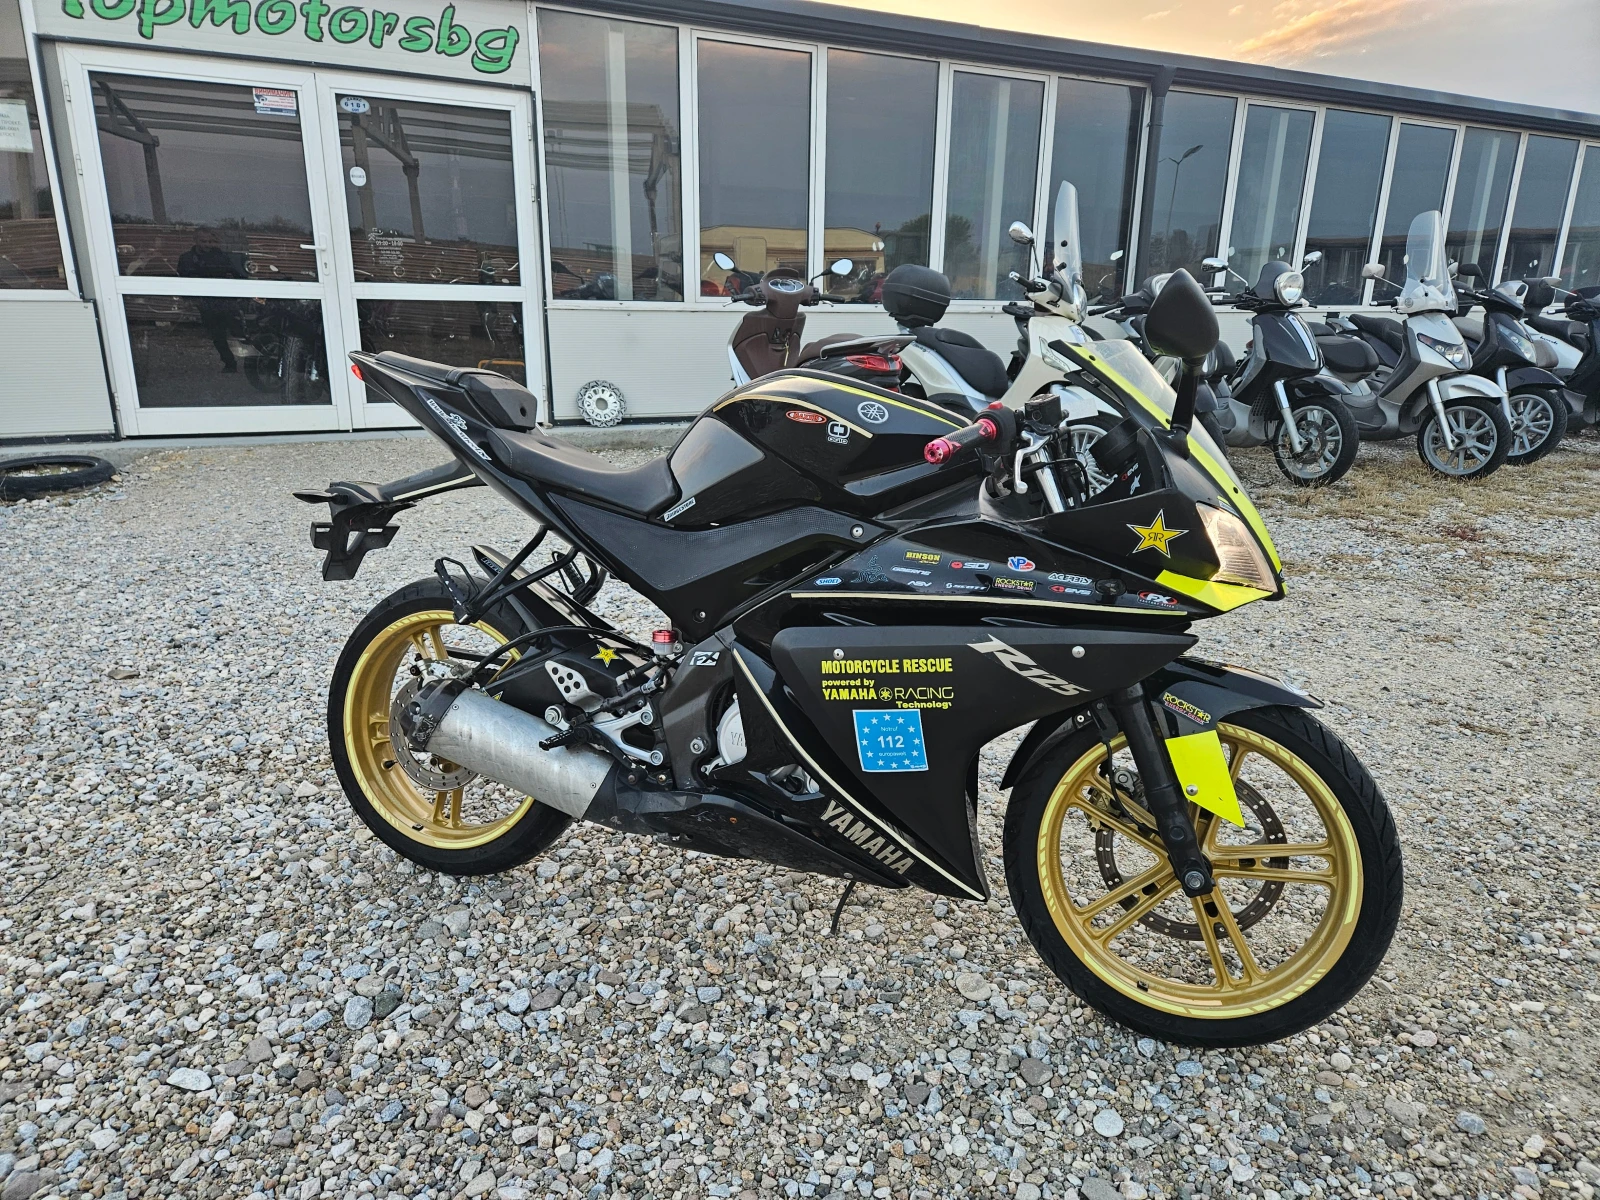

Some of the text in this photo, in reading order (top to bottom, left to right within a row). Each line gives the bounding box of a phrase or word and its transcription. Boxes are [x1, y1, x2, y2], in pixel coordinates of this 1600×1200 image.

[821, 657, 954, 674] MOTORCYCLE RESCUE
[822, 678, 875, 688] powered by
[822, 686, 955, 700] YAMAHA RACING
[877, 735, 905, 749] 112
[820, 799, 915, 875] YAMAHA
